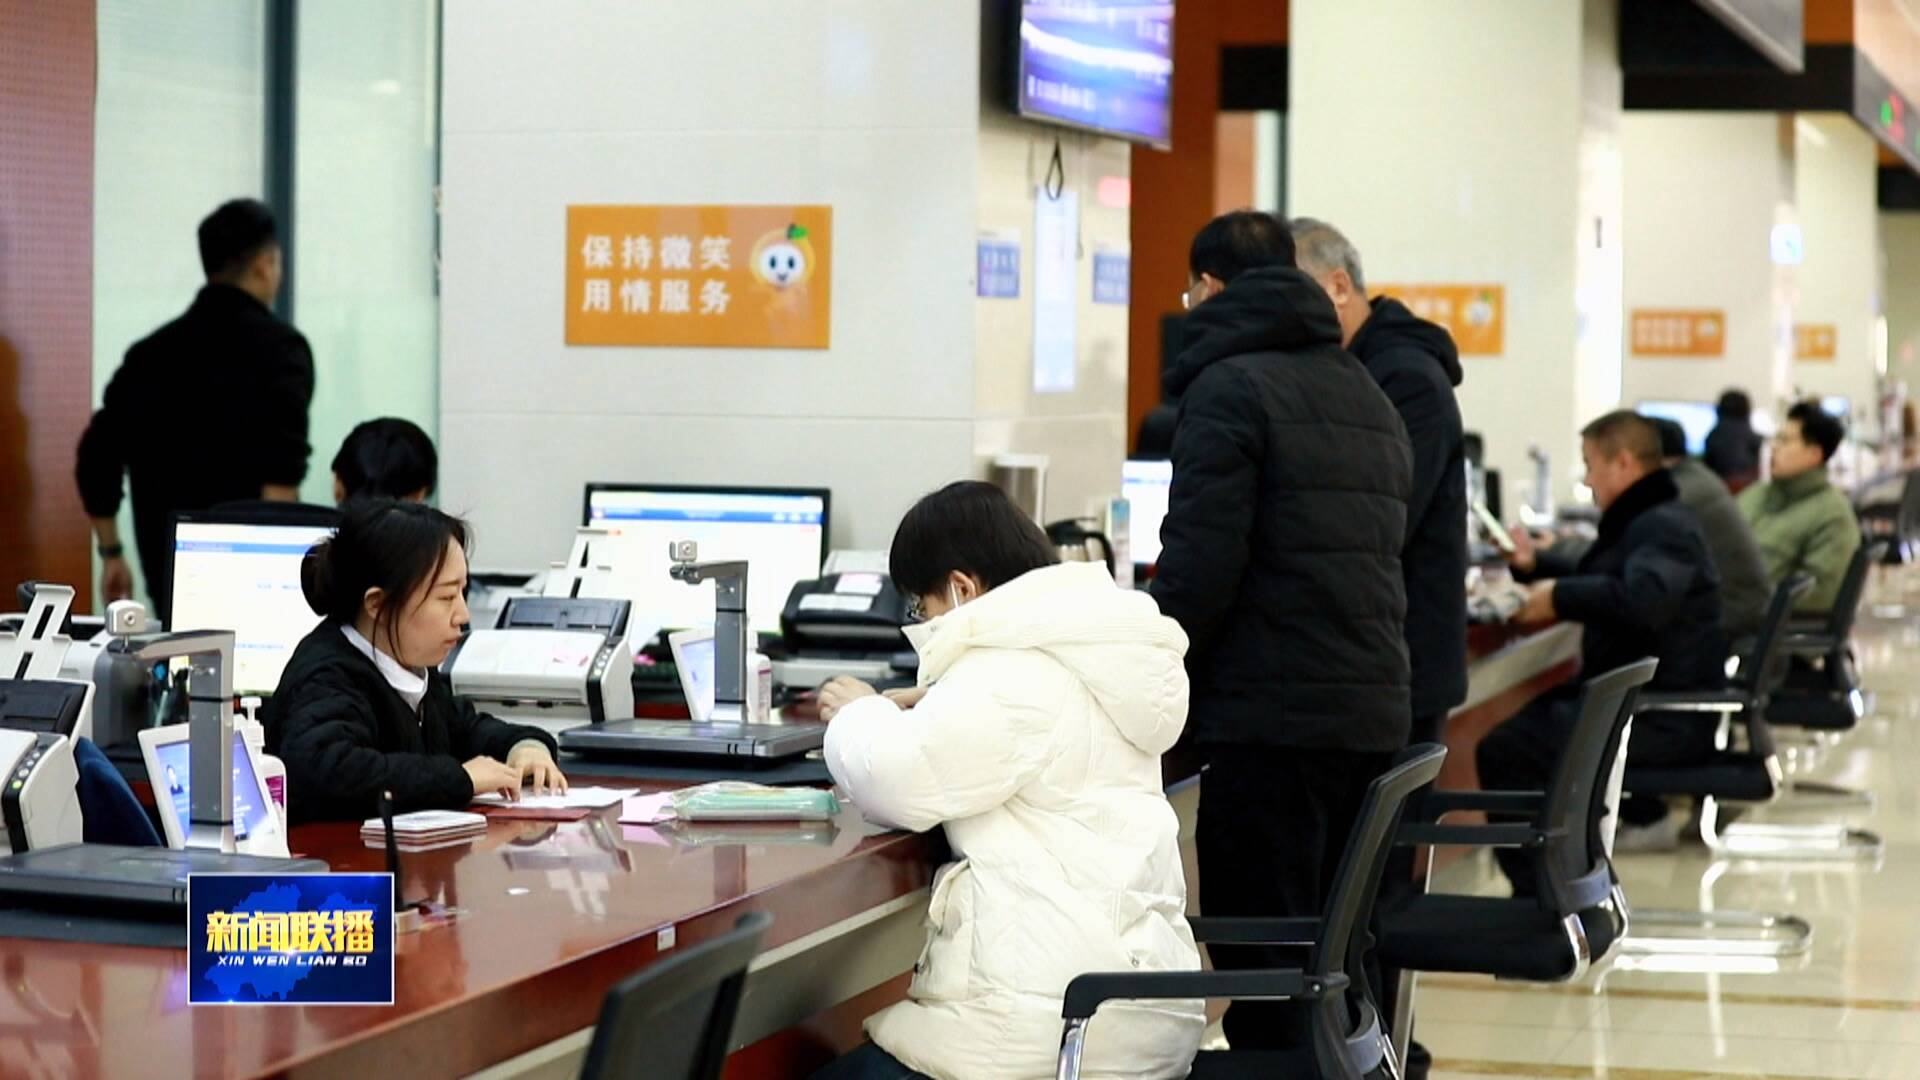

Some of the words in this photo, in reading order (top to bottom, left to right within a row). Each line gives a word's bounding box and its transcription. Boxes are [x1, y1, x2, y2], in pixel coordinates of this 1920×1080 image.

[581, 234, 731, 270] 保持微笑
[581, 278, 731, 315] 用情服务
